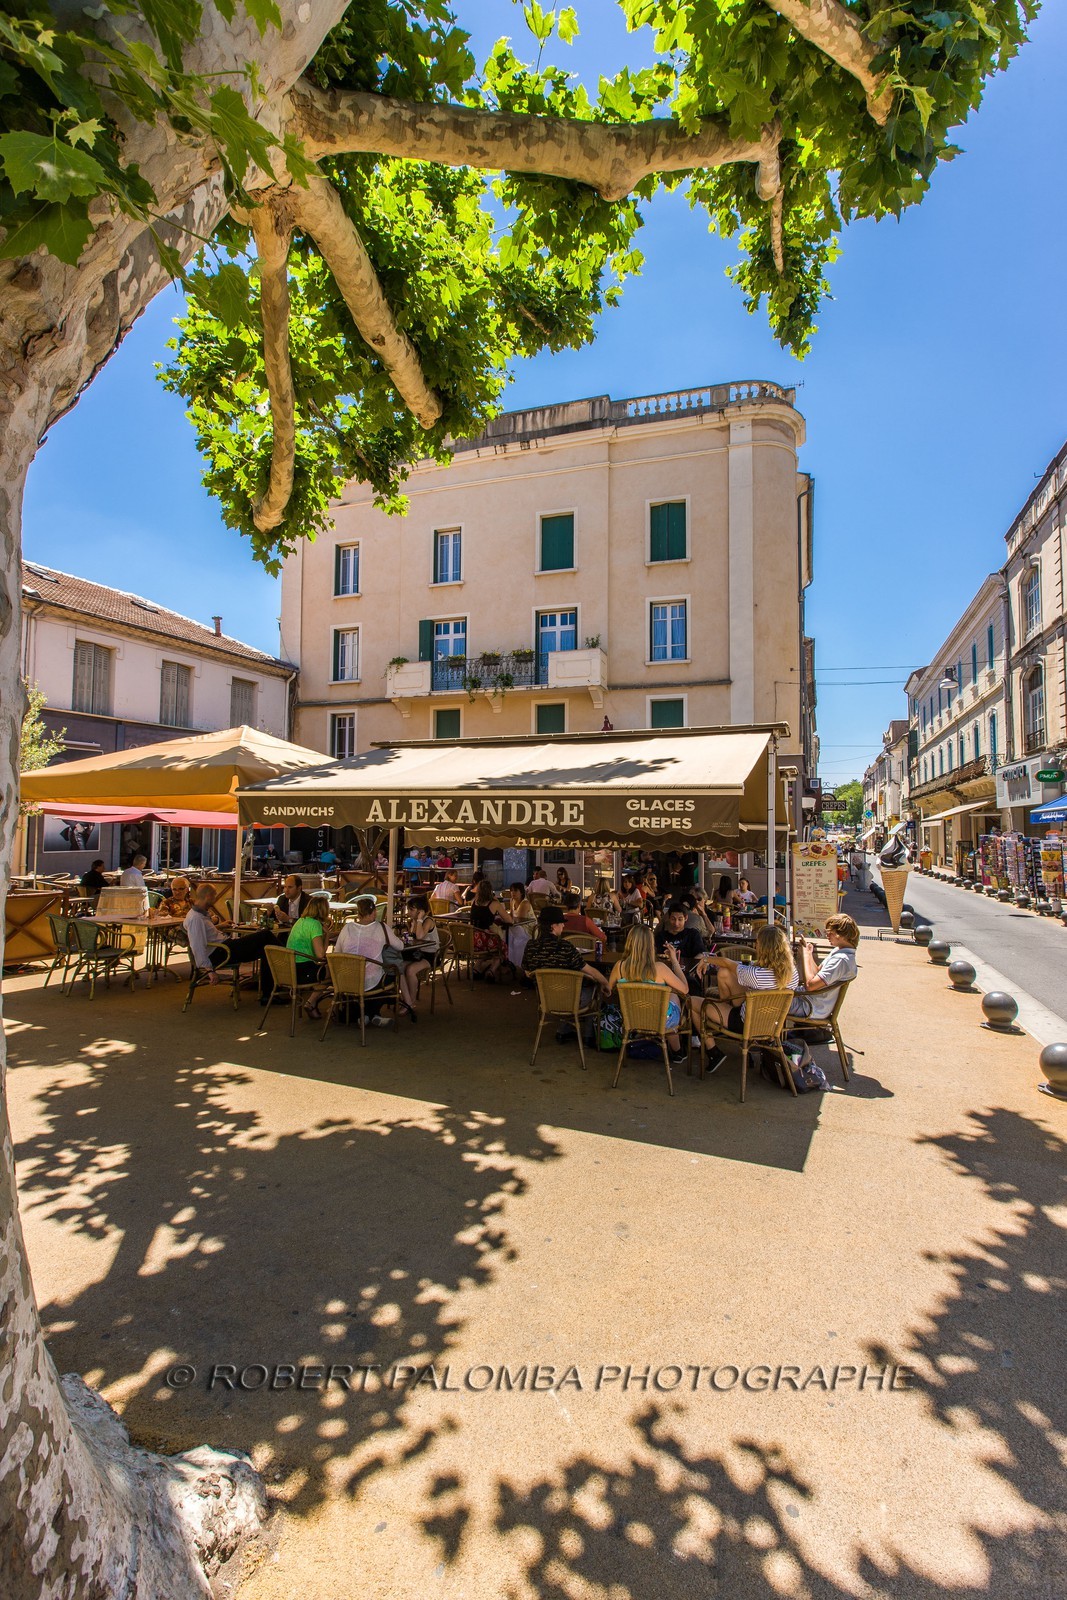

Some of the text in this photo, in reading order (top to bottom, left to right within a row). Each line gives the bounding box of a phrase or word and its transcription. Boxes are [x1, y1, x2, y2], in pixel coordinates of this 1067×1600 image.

[263, 806, 335, 817] SANDWICHS
[626, 799, 696, 812] GLACES
[821, 801, 846, 810] CREPES
[365, 799, 585, 826] ALEXANDRE
[628, 816, 693, 829] CREPES
[435, 835, 481, 843] SANDWICHS
